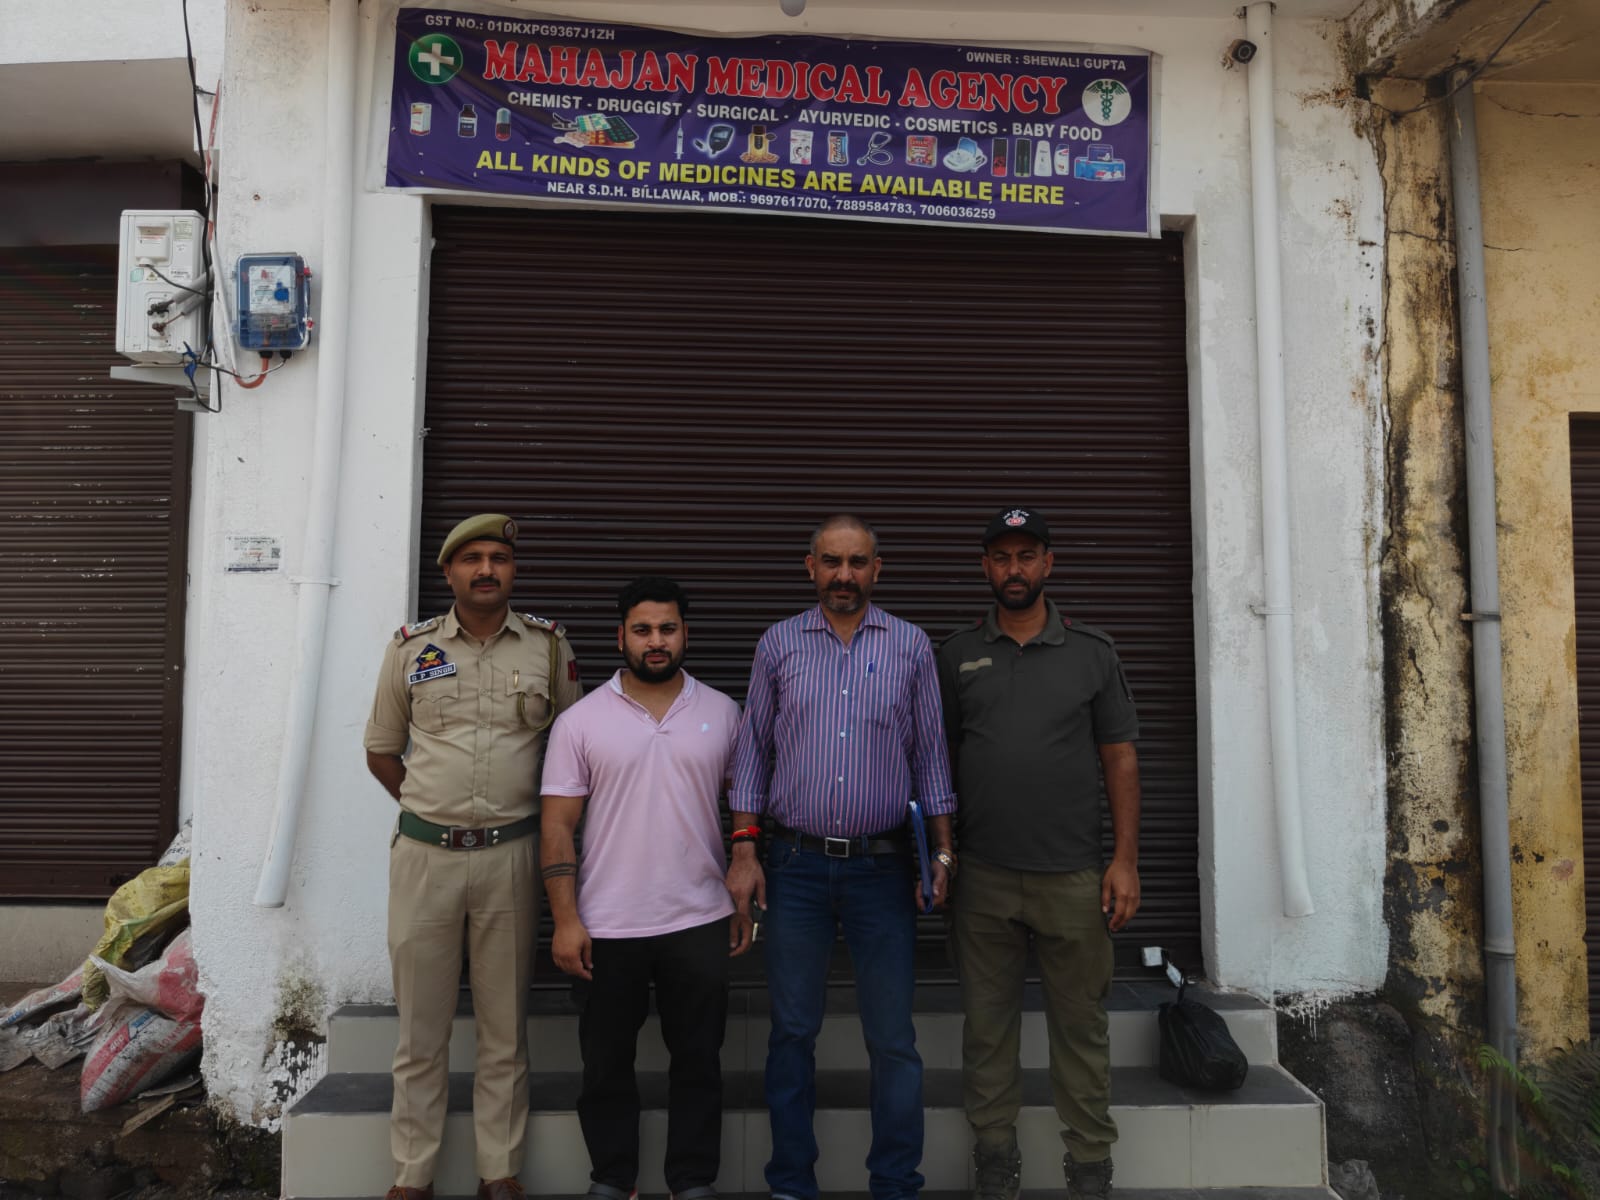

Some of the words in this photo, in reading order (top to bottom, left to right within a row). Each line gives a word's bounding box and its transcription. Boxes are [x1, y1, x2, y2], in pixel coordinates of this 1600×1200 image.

[425, 15, 452, 26] GST
[456, 17, 483, 30] NO.:
[482, 39, 699, 93] MAHAJAN
[705, 56, 890, 105] MEDICAL
[898, 67, 1067, 114] AGENCY
[1084, 58, 1127, 71] GUPTA
[507, 91, 583, 110] CHEMIST
[597, 98, 683, 116] DRUGGIST
[696, 104, 780, 121] SURGICAL
[798, 109, 891, 129] AYURVEDIC
[904, 116, 998, 135] COSMETICS
[1012, 122, 1054, 138] BABY
[1060, 125, 1103, 141] FOOD
[476, 150, 523, 172] ALL
[532, 154, 610, 178] KINDS
[618, 160, 651, 181] OF
[659, 162, 795, 189] MEDICINES
[803, 170, 852, 193] ARE
[860, 174, 993, 201] AVAILABLE
[1001, 183, 1064, 205] HERE
[547, 181, 584, 195] NEAR
[588, 185, 627, 198] S.D.H.
[632, 187, 704, 203] BILLAWAR,
[750, 194, 831, 211] 9697617070,
[835, 199, 915, 216] 7889584783,
[919, 204, 996, 219] 7006036259
